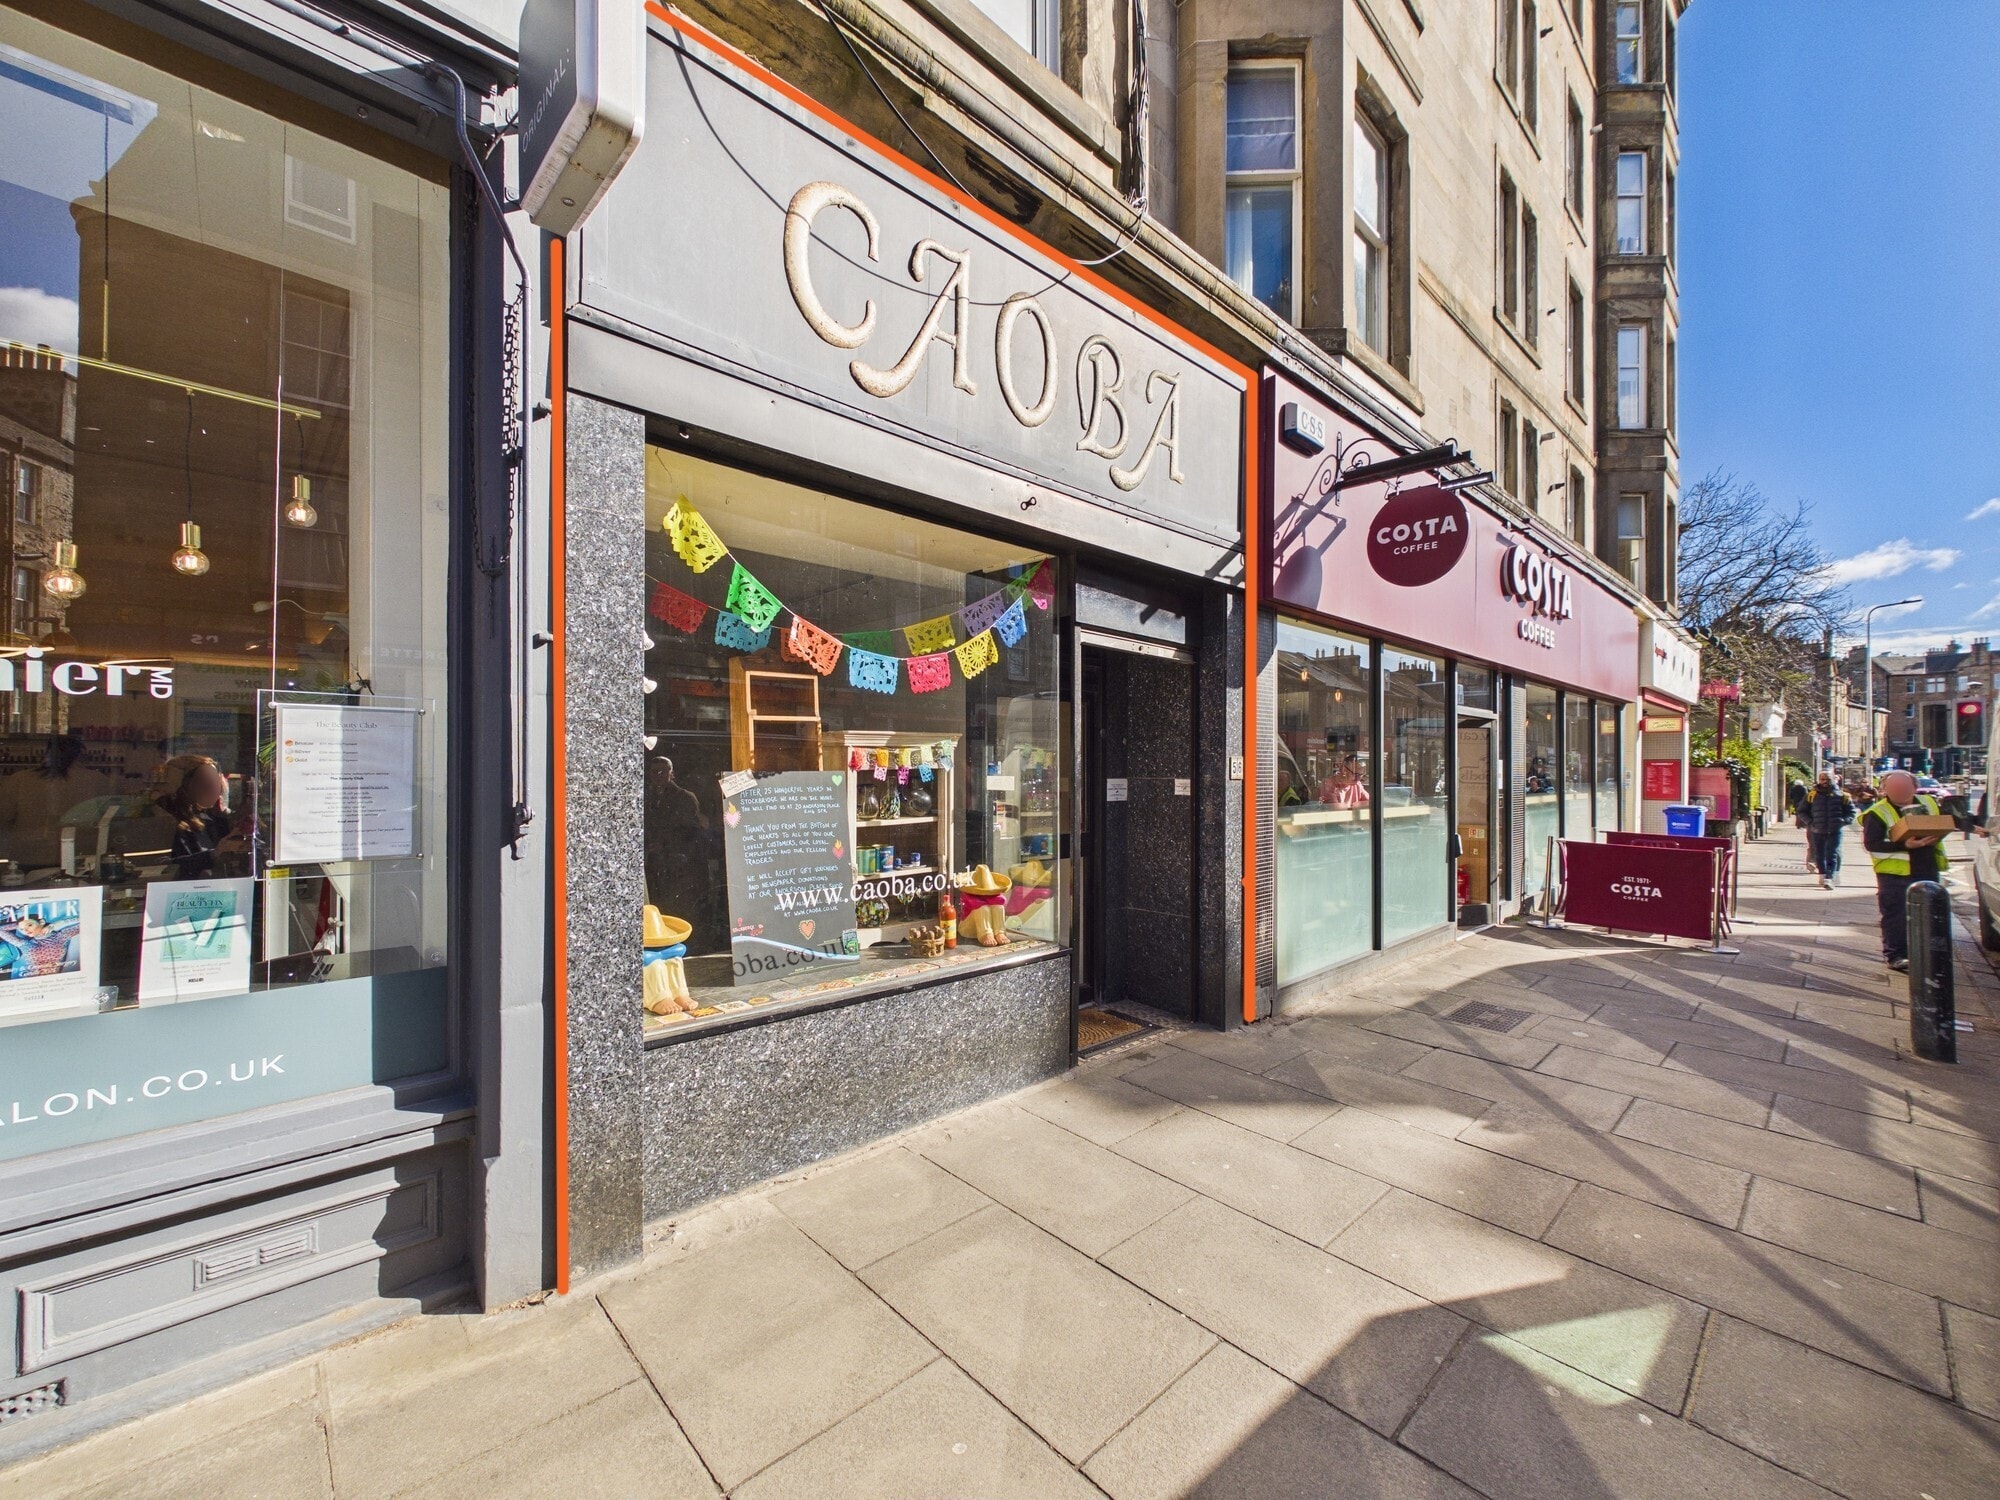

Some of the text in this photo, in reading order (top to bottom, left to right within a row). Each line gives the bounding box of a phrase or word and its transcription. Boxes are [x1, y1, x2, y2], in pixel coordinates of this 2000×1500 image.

[783, 180, 1185, 492] CAOBA
[1376, 515, 1458, 545] COSTA
[1393, 541, 1438, 555] COFFEE
[1512, 544, 1573, 620] COSTA
[1521, 618, 1556, 649] COFFEE
[149, 668, 173, 699] MD
[740, 788, 762, 798] AFTER
[764, 787, 772, 795] 25
[744, 823, 766, 834] THANK
[767, 823, 780, 831] YOU
[781, 822, 797, 831] FROM
[775, 867, 797, 878] ACCEPT
[777, 864, 979, 911] www.caoba.co.uk
[1610, 883, 1662, 898] COSTA
